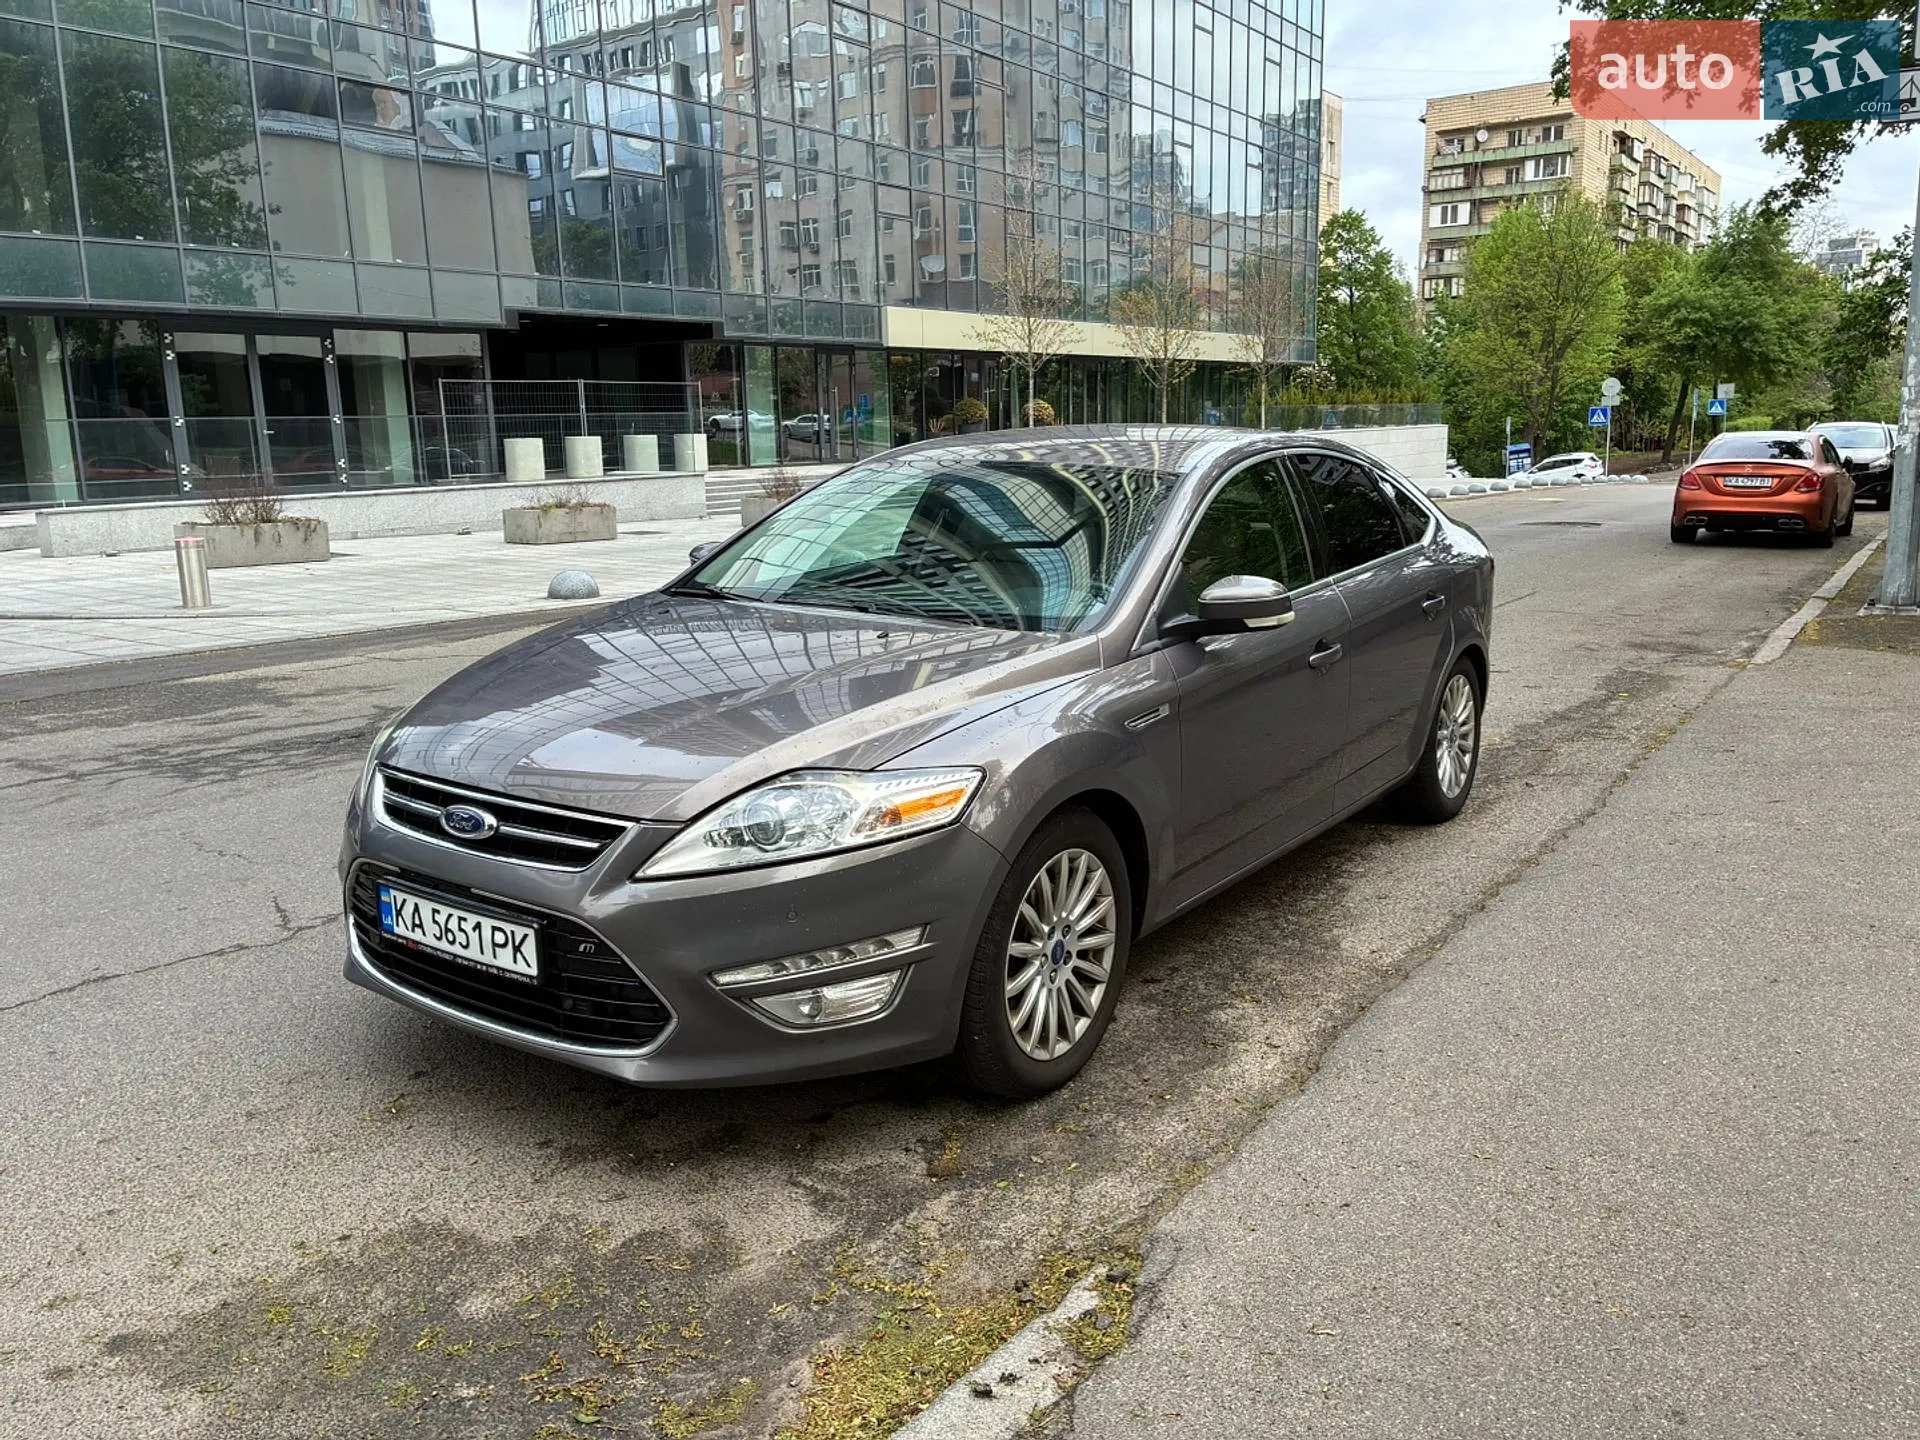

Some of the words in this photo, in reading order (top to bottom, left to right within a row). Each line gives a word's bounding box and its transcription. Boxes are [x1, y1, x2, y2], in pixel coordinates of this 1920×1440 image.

[449, 812, 479, 831] Ford
[382, 913, 393, 926] UA
[393, 894, 427, 937] KA
[432, 907, 484, 956] 5651
[491, 925, 532, 968] PK
